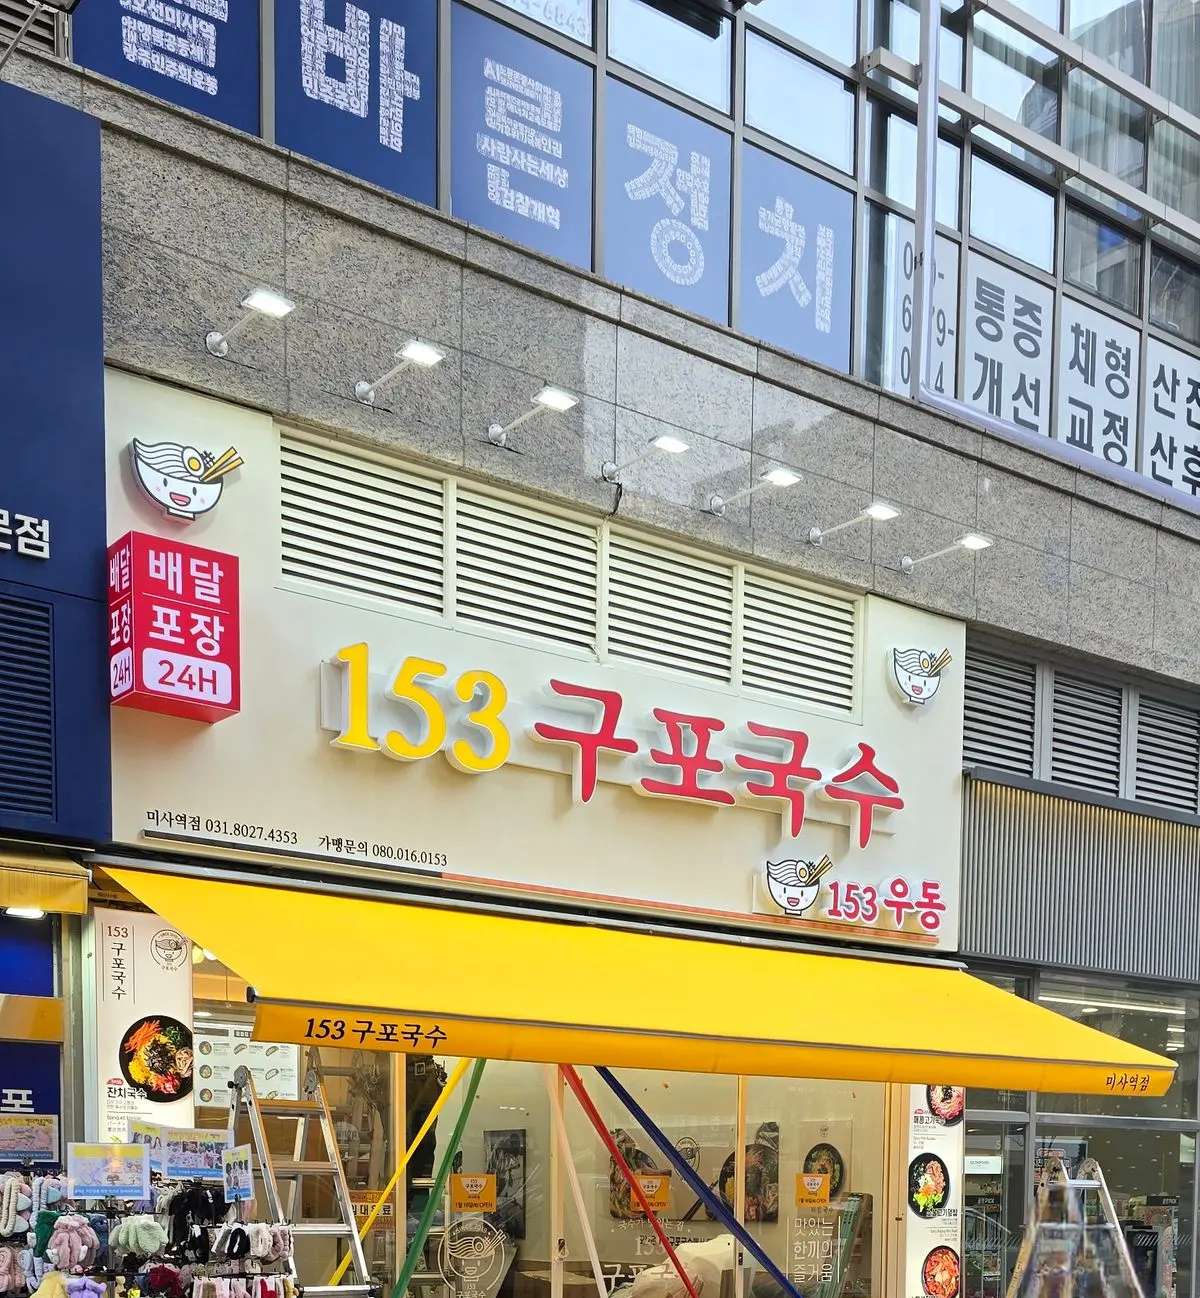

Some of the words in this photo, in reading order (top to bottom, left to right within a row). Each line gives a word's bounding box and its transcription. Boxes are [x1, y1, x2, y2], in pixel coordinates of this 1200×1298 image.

[974, 277, 1042, 359] 통증
[1069, 322, 1131, 400] 체형
[973, 352, 1040, 434] 개선
[1066, 396, 1129, 468] 교정
[110, 545, 130, 592] 배달
[149, 550, 224, 604] 배달
[110, 600, 131, 647] 포장
[149, 605, 224, 657] 포장
[113, 660, 131, 690] 24H
[158, 659, 217, 695] 24H
[331, 641, 511, 774] 153
[534, 679, 905, 850] 구포국수
[146, 809, 201, 832] 미사역점
[205, 817, 298, 845] 031.8027.4353
[318, 835, 368, 857] 가맹문의
[372, 842, 448, 866] 080.016.0153
[827, 880, 879, 925] 153
[883, 876, 947, 932] 우동
[107, 926, 129, 938] 153
[111, 942, 127, 1000] 구포국수
[304, 1017, 346, 1040] 153
[352, 1019, 447, 1050] 구포국수
[0, 1088, 35, 1113] 포
[107, 1086, 147, 1100] 잔치국수
[1105, 1072, 1150, 1092] 미사역점
[794, 1217, 834, 1237] 맛있는
[794, 1240, 833, 1260] 한끼의
[794, 1263, 833, 1283] 즐거움
